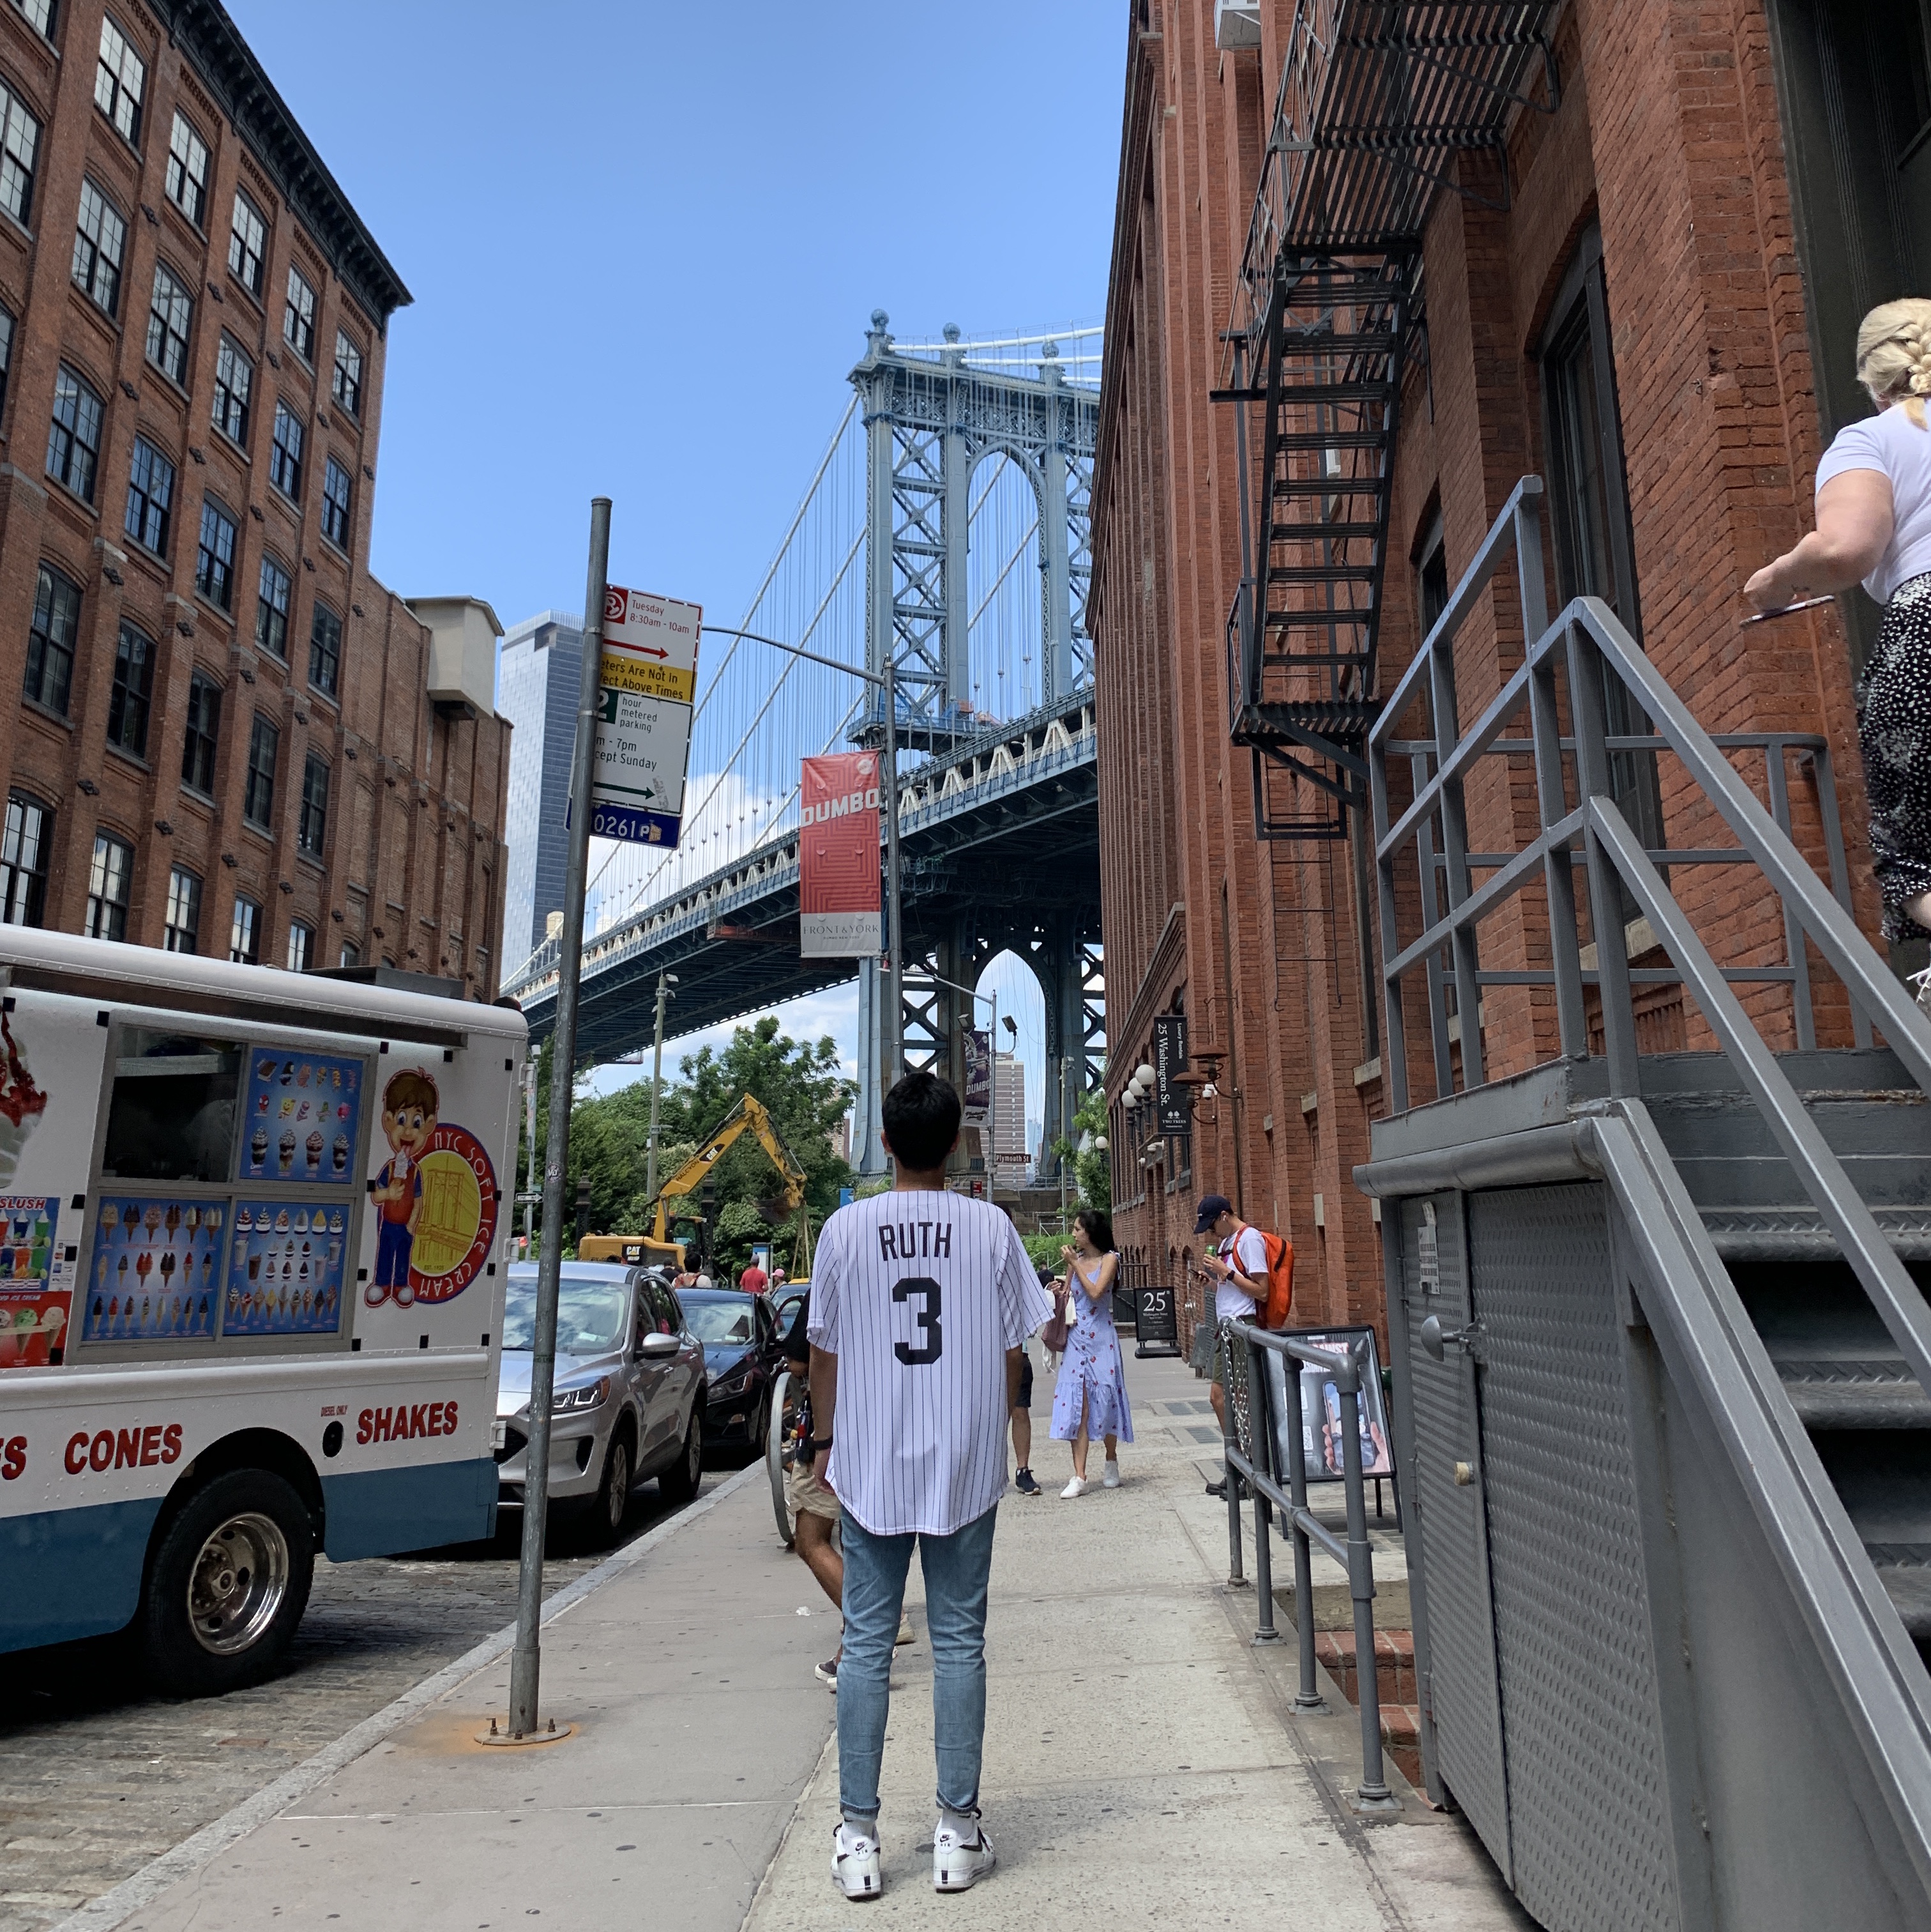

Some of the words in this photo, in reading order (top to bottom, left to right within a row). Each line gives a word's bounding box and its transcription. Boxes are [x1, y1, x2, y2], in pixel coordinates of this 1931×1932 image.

[632, 600, 664, 616] Tuesday
[630, 613, 661, 627] 8:30am
[669, 622, 689, 634] 10am
[628, 665, 644, 677] Are
[649, 667, 665, 681] Not
[669, 673, 678, 683] In
[622, 678, 651, 693] Above
[656, 684, 683, 700] Times
[623, 697, 642, 708] hour
[621, 709, 657, 722] metered
[620, 719, 651, 733] parking
[617, 738, 636, 752] 7pm
[620, 754, 657, 772] Sunday
[801, 788, 879, 828] DUMBO
[1158, 1024, 1167, 1035] 25
[1156, 1037, 1169, 1092] Washington
[966, 1079, 990, 1095] DUMBO
[1160, 1094, 1170, 1106] St.
[435, 1131, 462, 1152] NYC
[706, 1147, 718, 1160] CAT
[467, 1147, 494, 1201] SOFT
[676, 1159, 699, 1181] HALCYON
[0, 1198, 47, 1210] SLUSH
[474, 1219, 492, 1254] ICE
[879, 1222, 952, 1261] RUTH
[626, 1246, 640, 1255] CAT
[419, 1262, 471, 1297] CREAM
[1144, 1291, 1166, 1311] 25
[892, 1277, 942, 1365] 3
[356, 1401, 458, 1444] SHAKES
[64, 1424, 183, 1475] CONES
